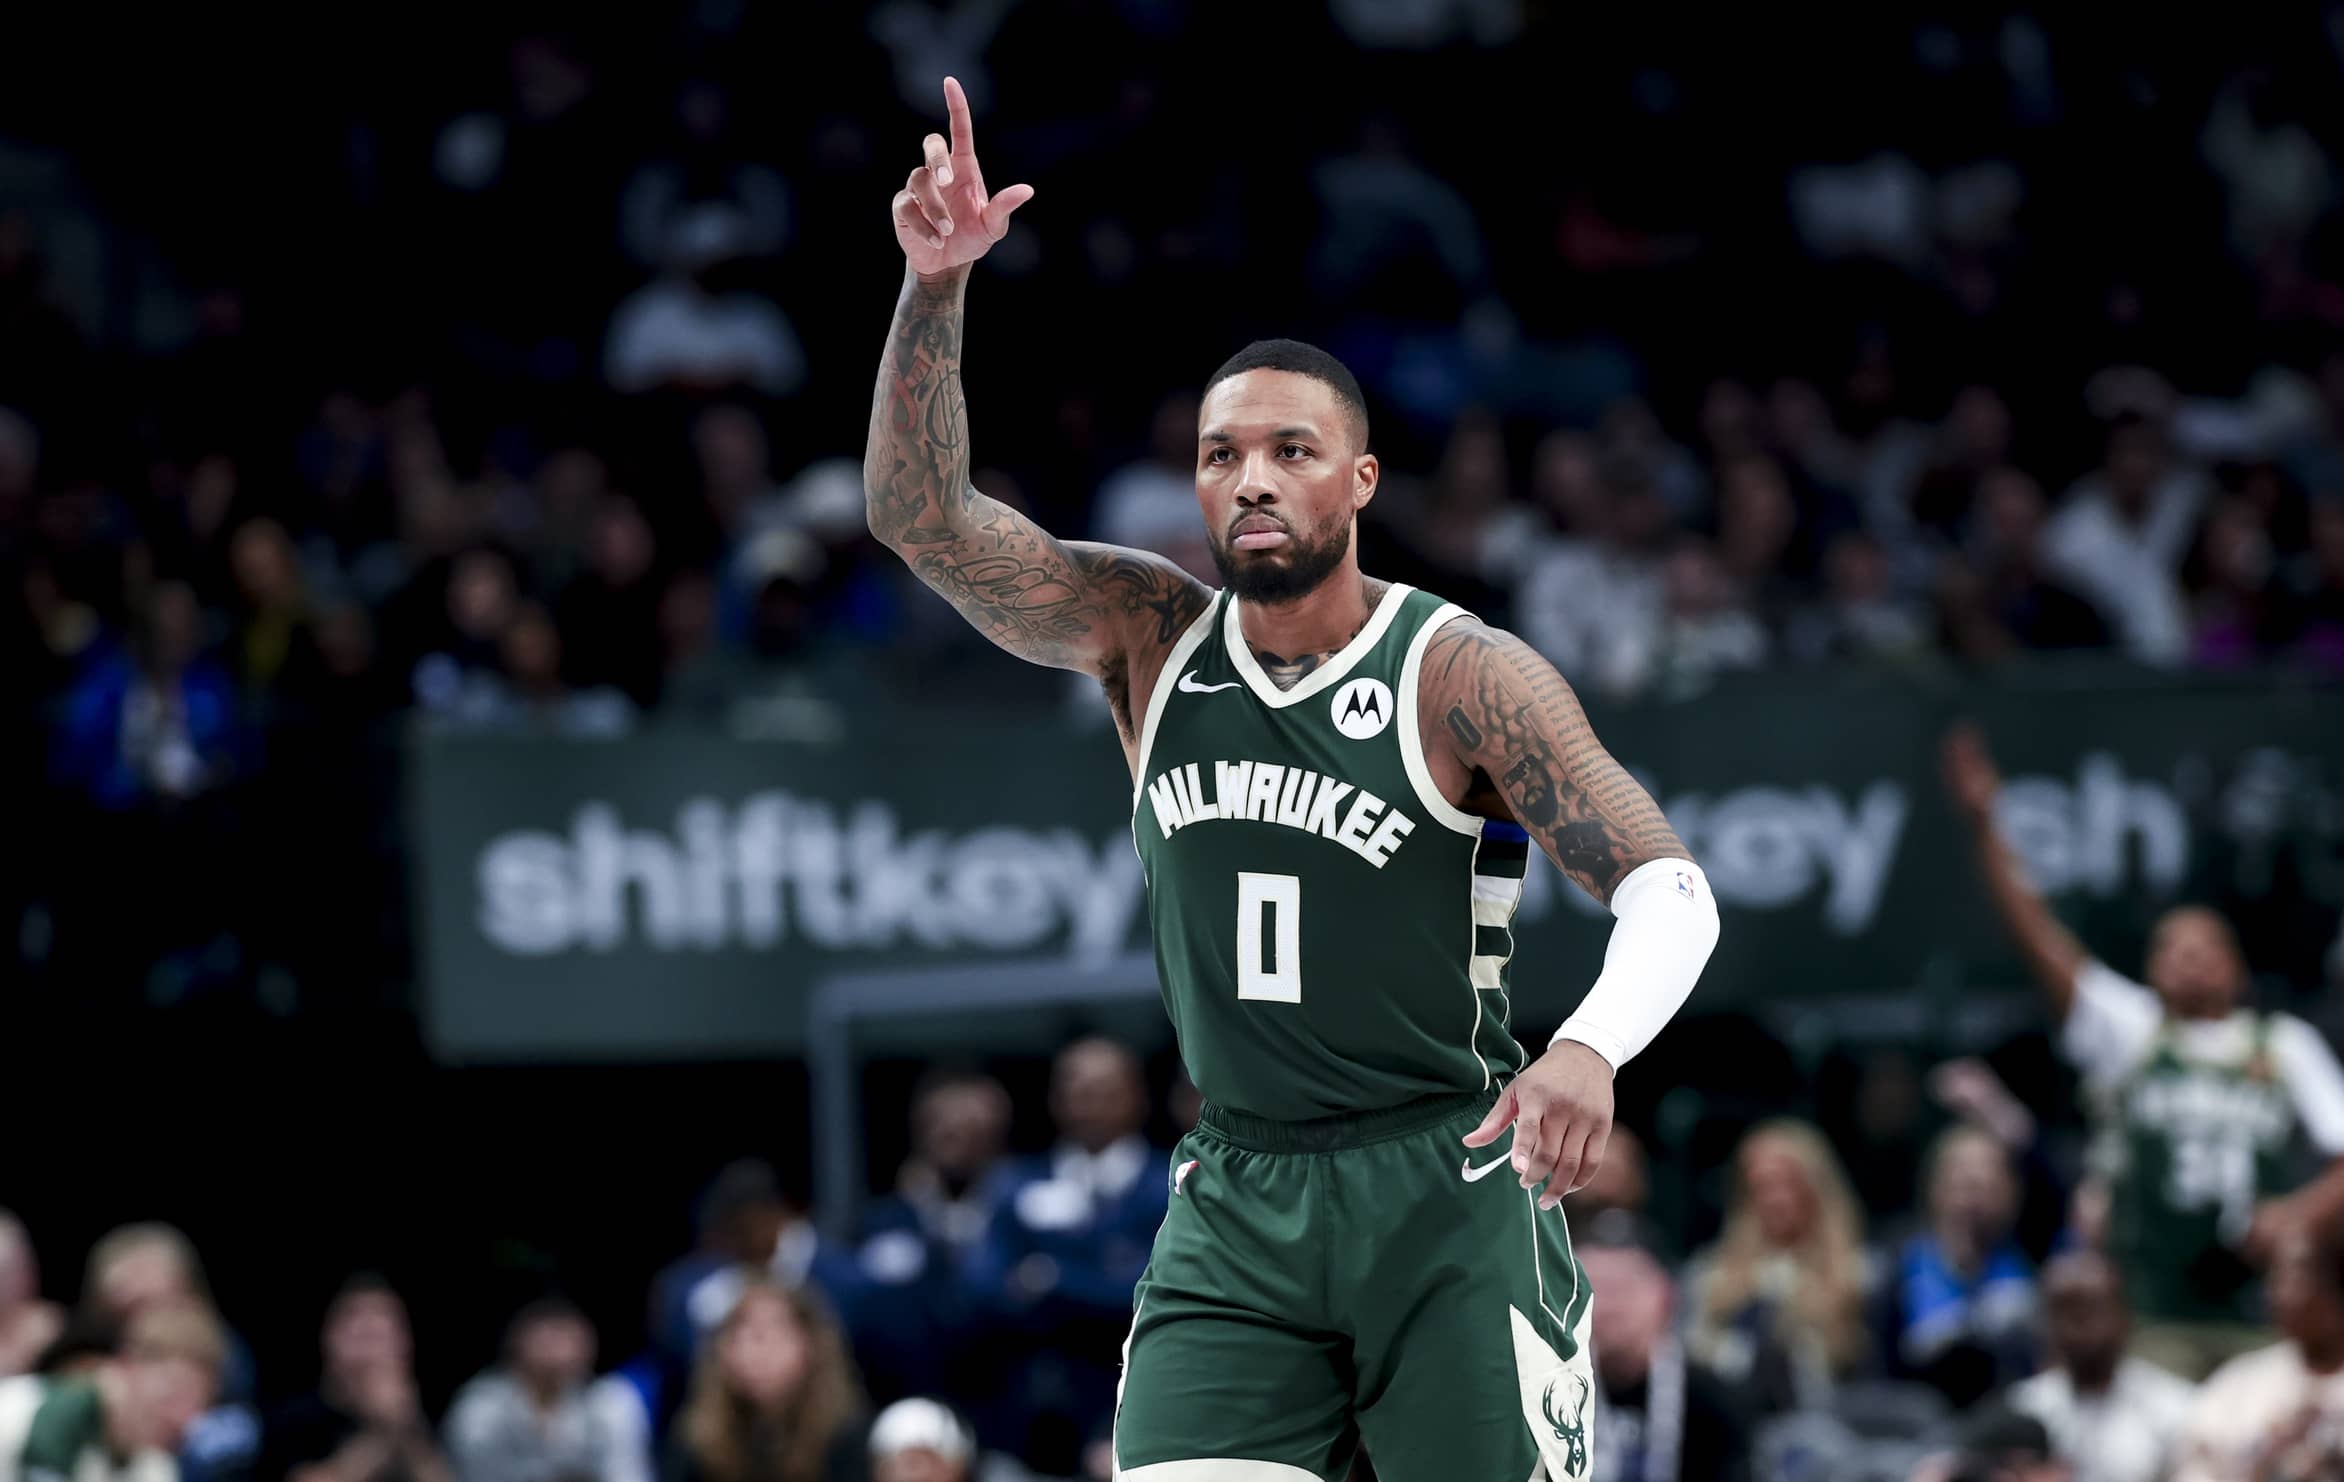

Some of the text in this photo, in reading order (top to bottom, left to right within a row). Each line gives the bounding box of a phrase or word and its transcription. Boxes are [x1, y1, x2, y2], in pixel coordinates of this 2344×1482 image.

[480, 790, 1142, 973] shiftkey
[1147, 760, 1417, 870] MILWAUKEE
[1237, 871, 1301, 1004] 0
